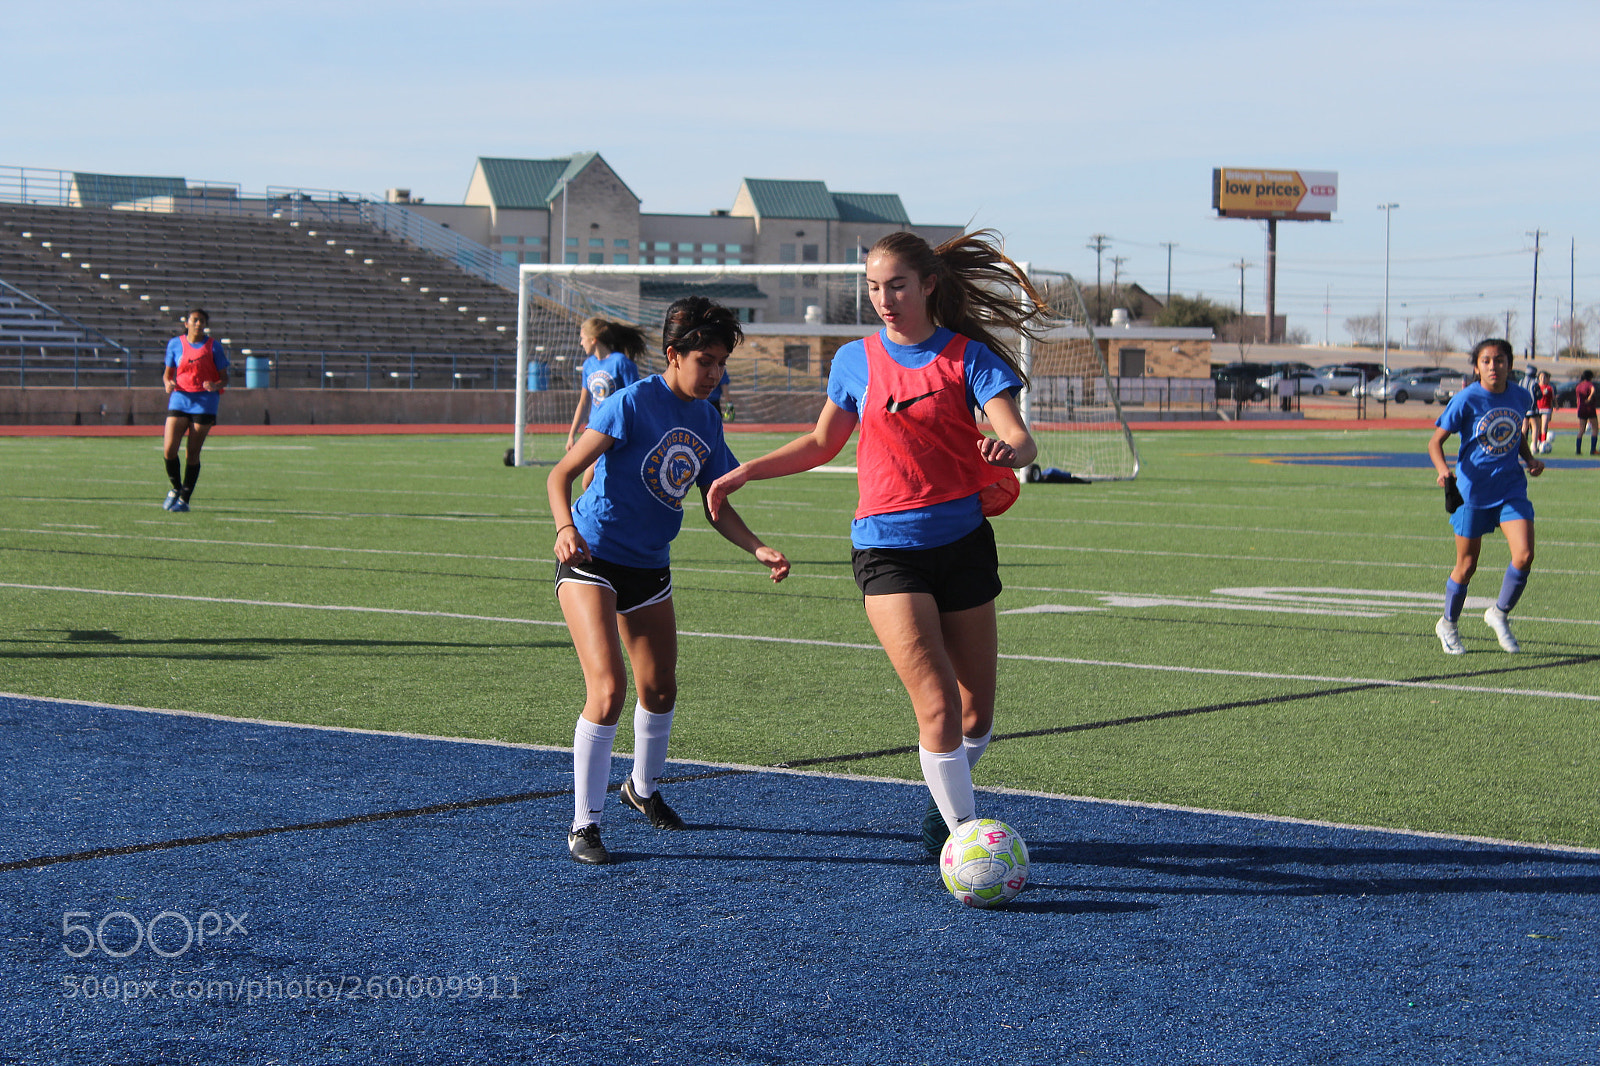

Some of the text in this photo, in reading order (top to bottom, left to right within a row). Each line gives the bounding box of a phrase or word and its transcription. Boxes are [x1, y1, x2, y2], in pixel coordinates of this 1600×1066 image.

[1225, 181, 1251, 195] low
[1256, 182, 1300, 197] prices
[650, 432, 708, 465] PFLUGERVILL
